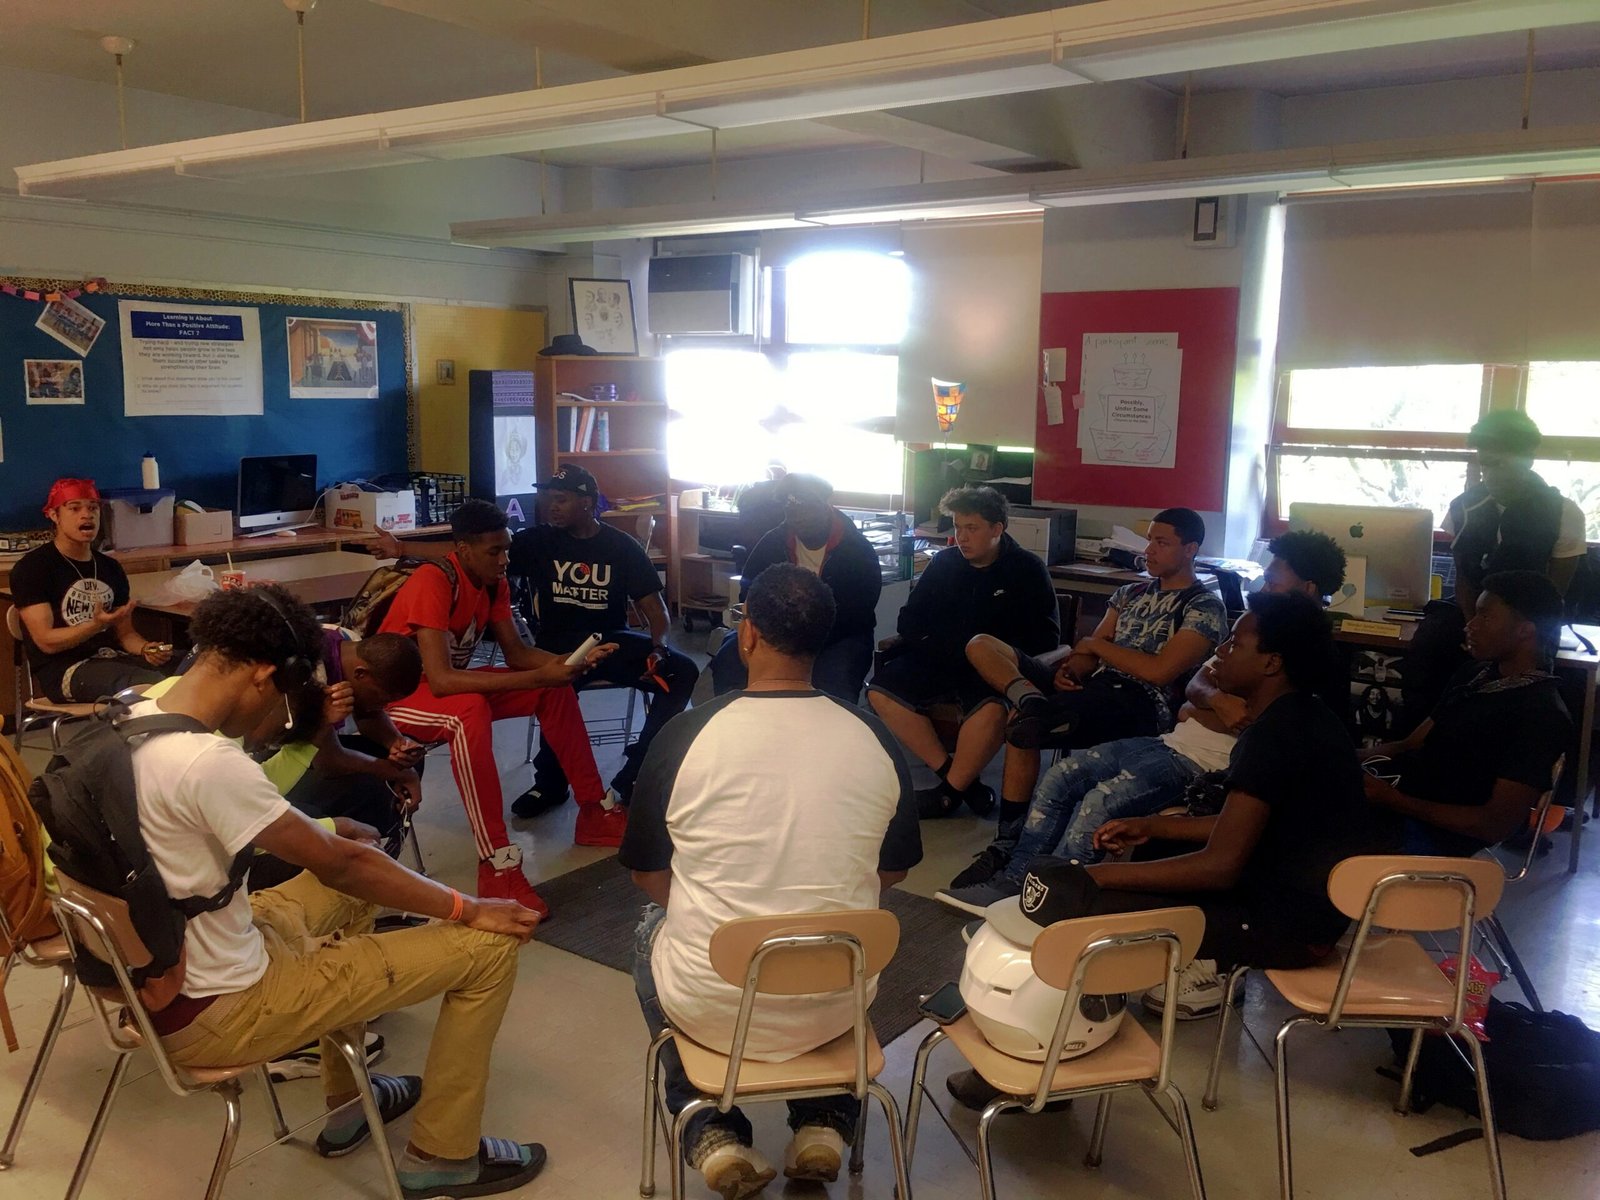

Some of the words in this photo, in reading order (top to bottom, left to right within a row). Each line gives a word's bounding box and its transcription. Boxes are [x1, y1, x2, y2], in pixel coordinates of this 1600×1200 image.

[163, 314, 188, 322] Learning
[1120, 399, 1144, 407] Possibly,
[553, 559, 611, 587] YOU
[552, 581, 609, 601] MATTER
[66, 596, 90, 617] NEW
